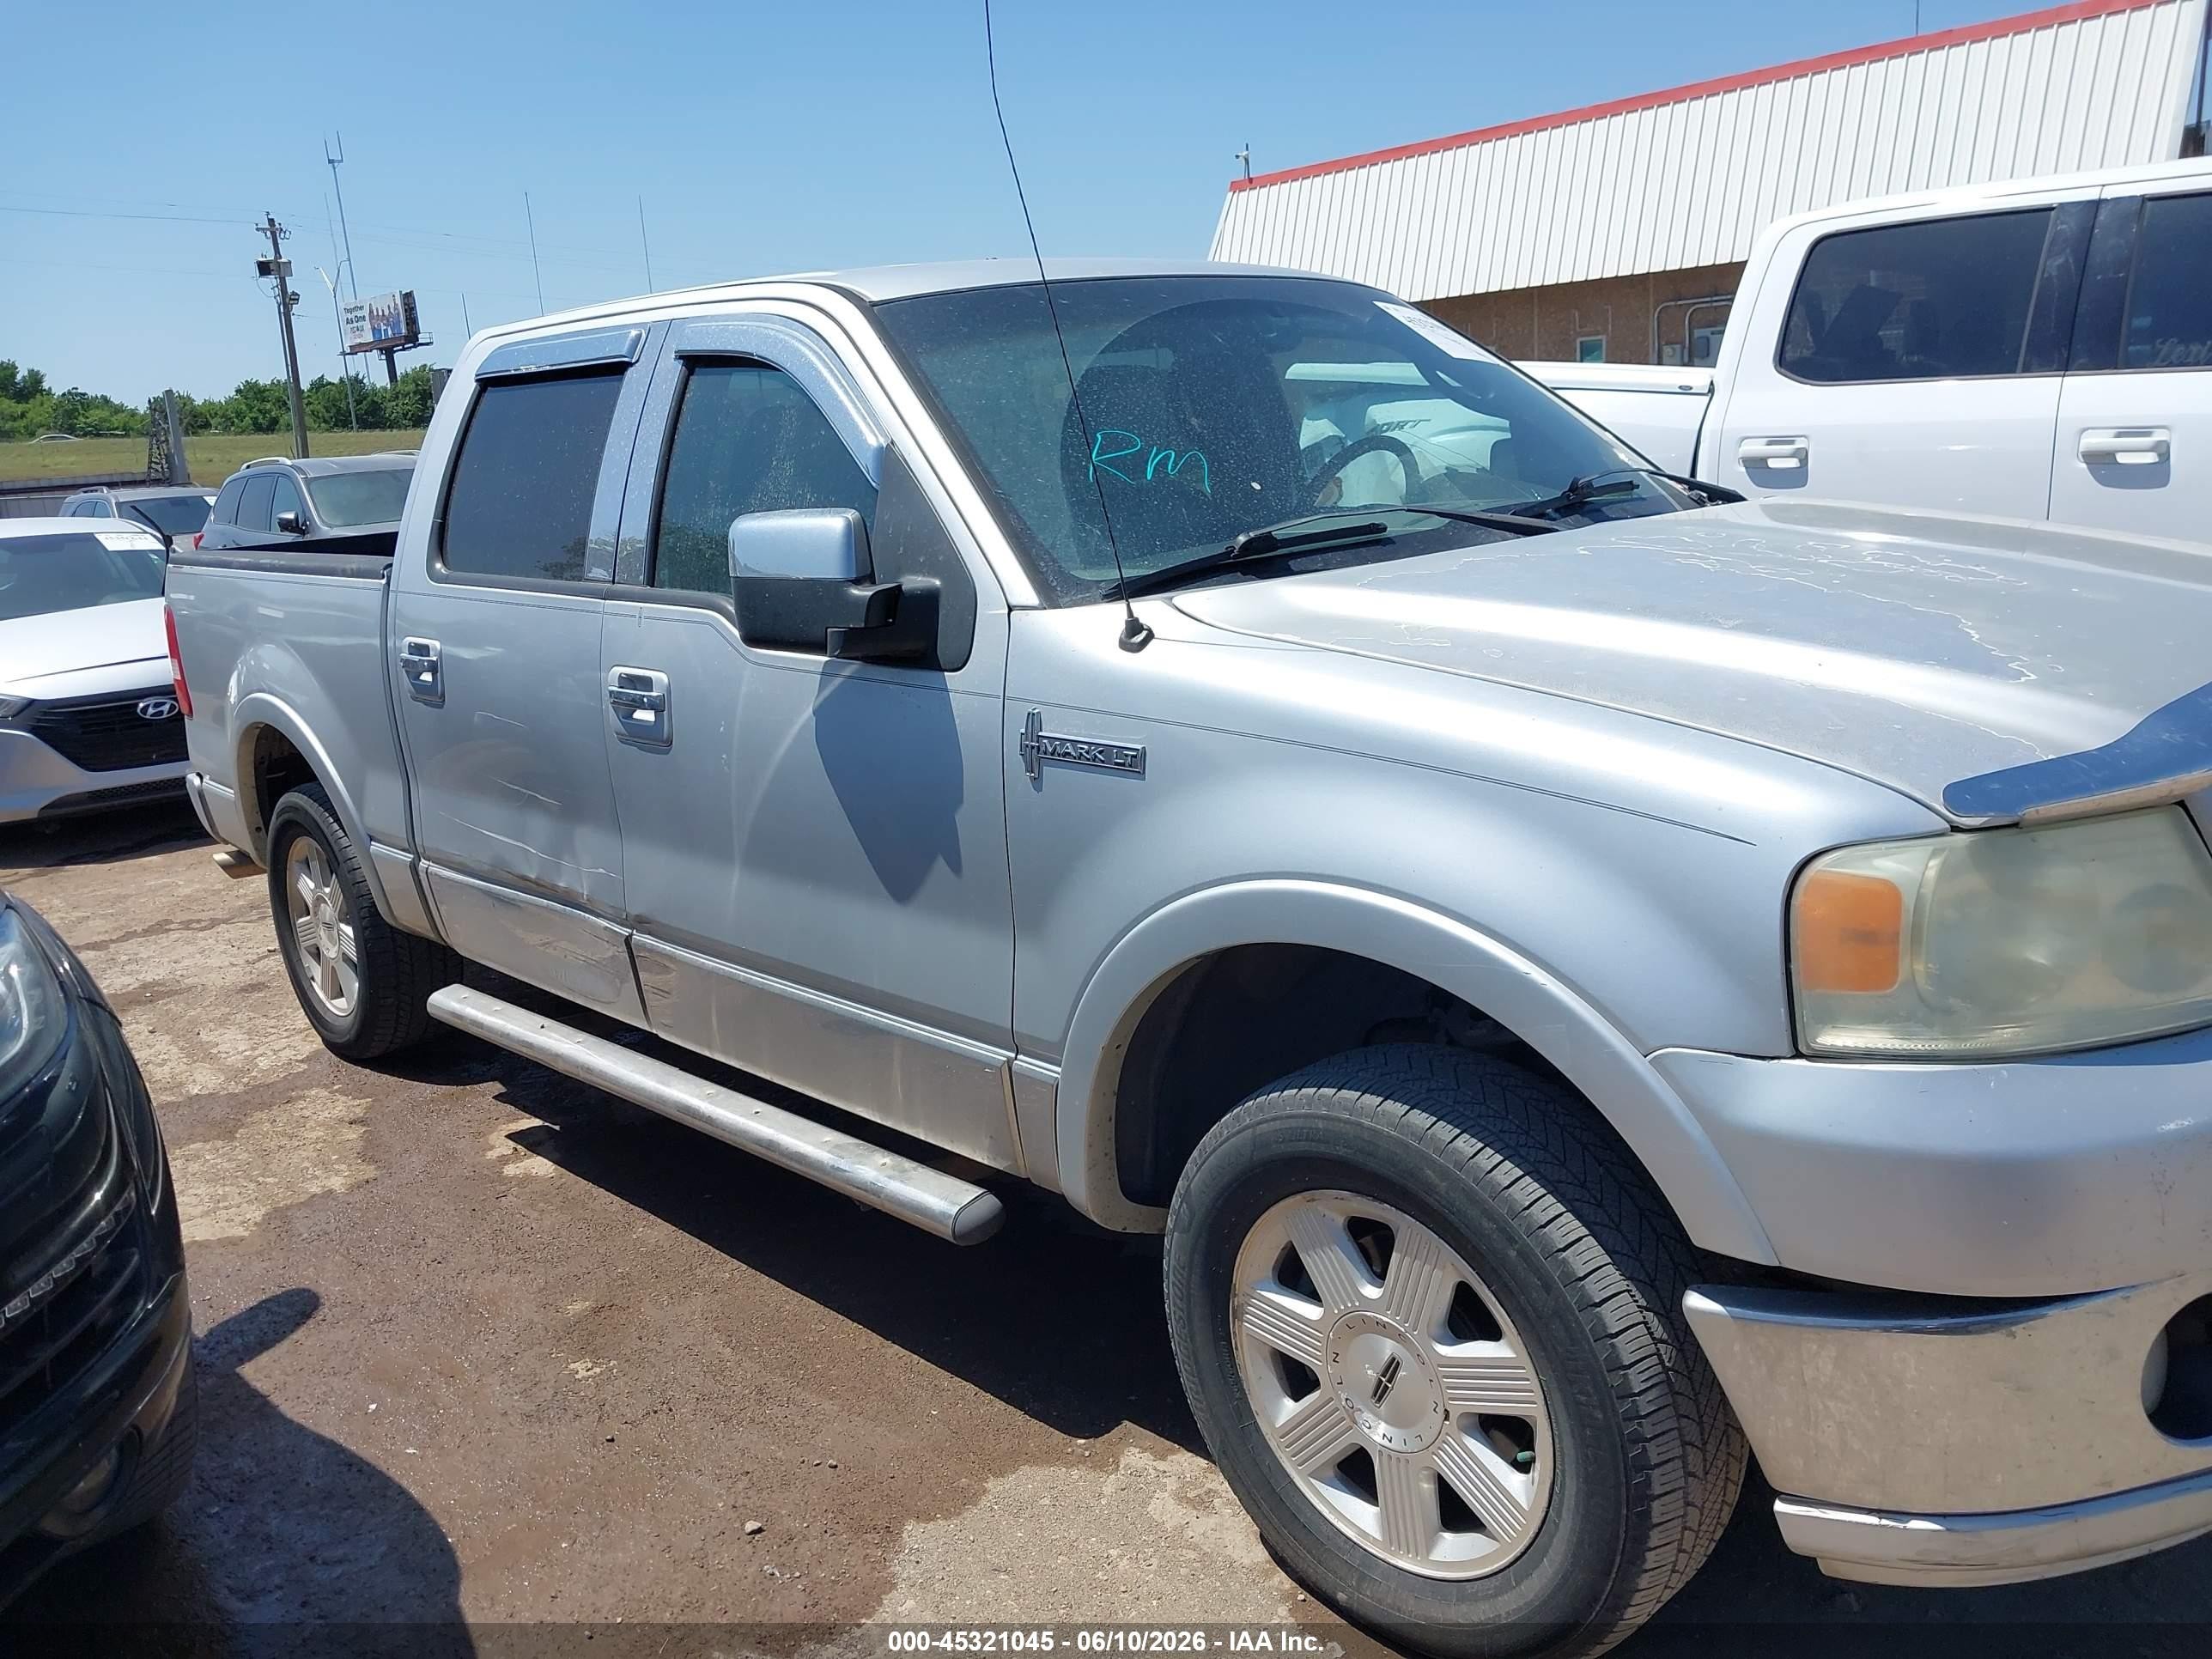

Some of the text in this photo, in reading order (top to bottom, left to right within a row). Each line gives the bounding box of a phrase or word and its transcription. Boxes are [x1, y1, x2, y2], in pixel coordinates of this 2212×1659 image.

[343, 305, 365, 315] Together
[346, 314, 367, 325] As One
[1042, 739, 1138, 768] MARK LT
[1345, 1318, 1440, 1415] LINCOLN
